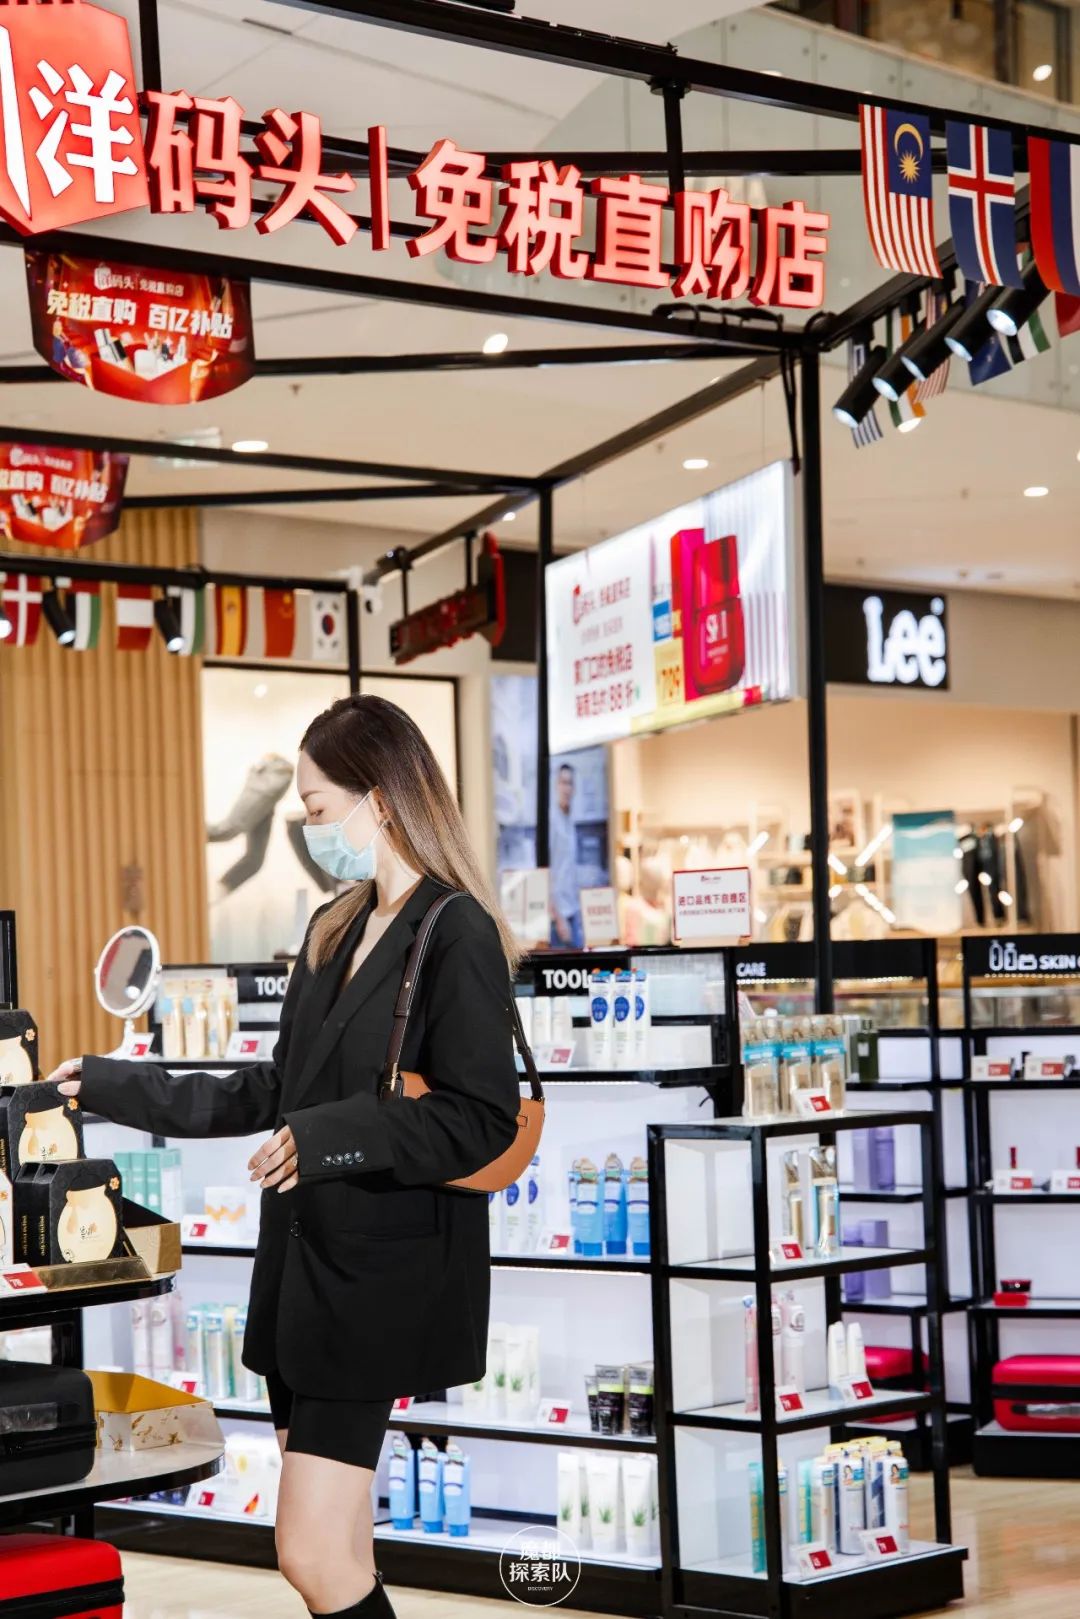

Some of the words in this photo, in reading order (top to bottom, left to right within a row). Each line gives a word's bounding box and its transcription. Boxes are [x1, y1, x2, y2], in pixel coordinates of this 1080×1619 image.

[47, 289, 137, 326] 免税直购
[148, 302, 234, 339] 百亿补贴
[863, 595, 947, 687] Lee
[736, 962, 767, 977] CARE
[1039, 954, 1076, 970] SKIN
